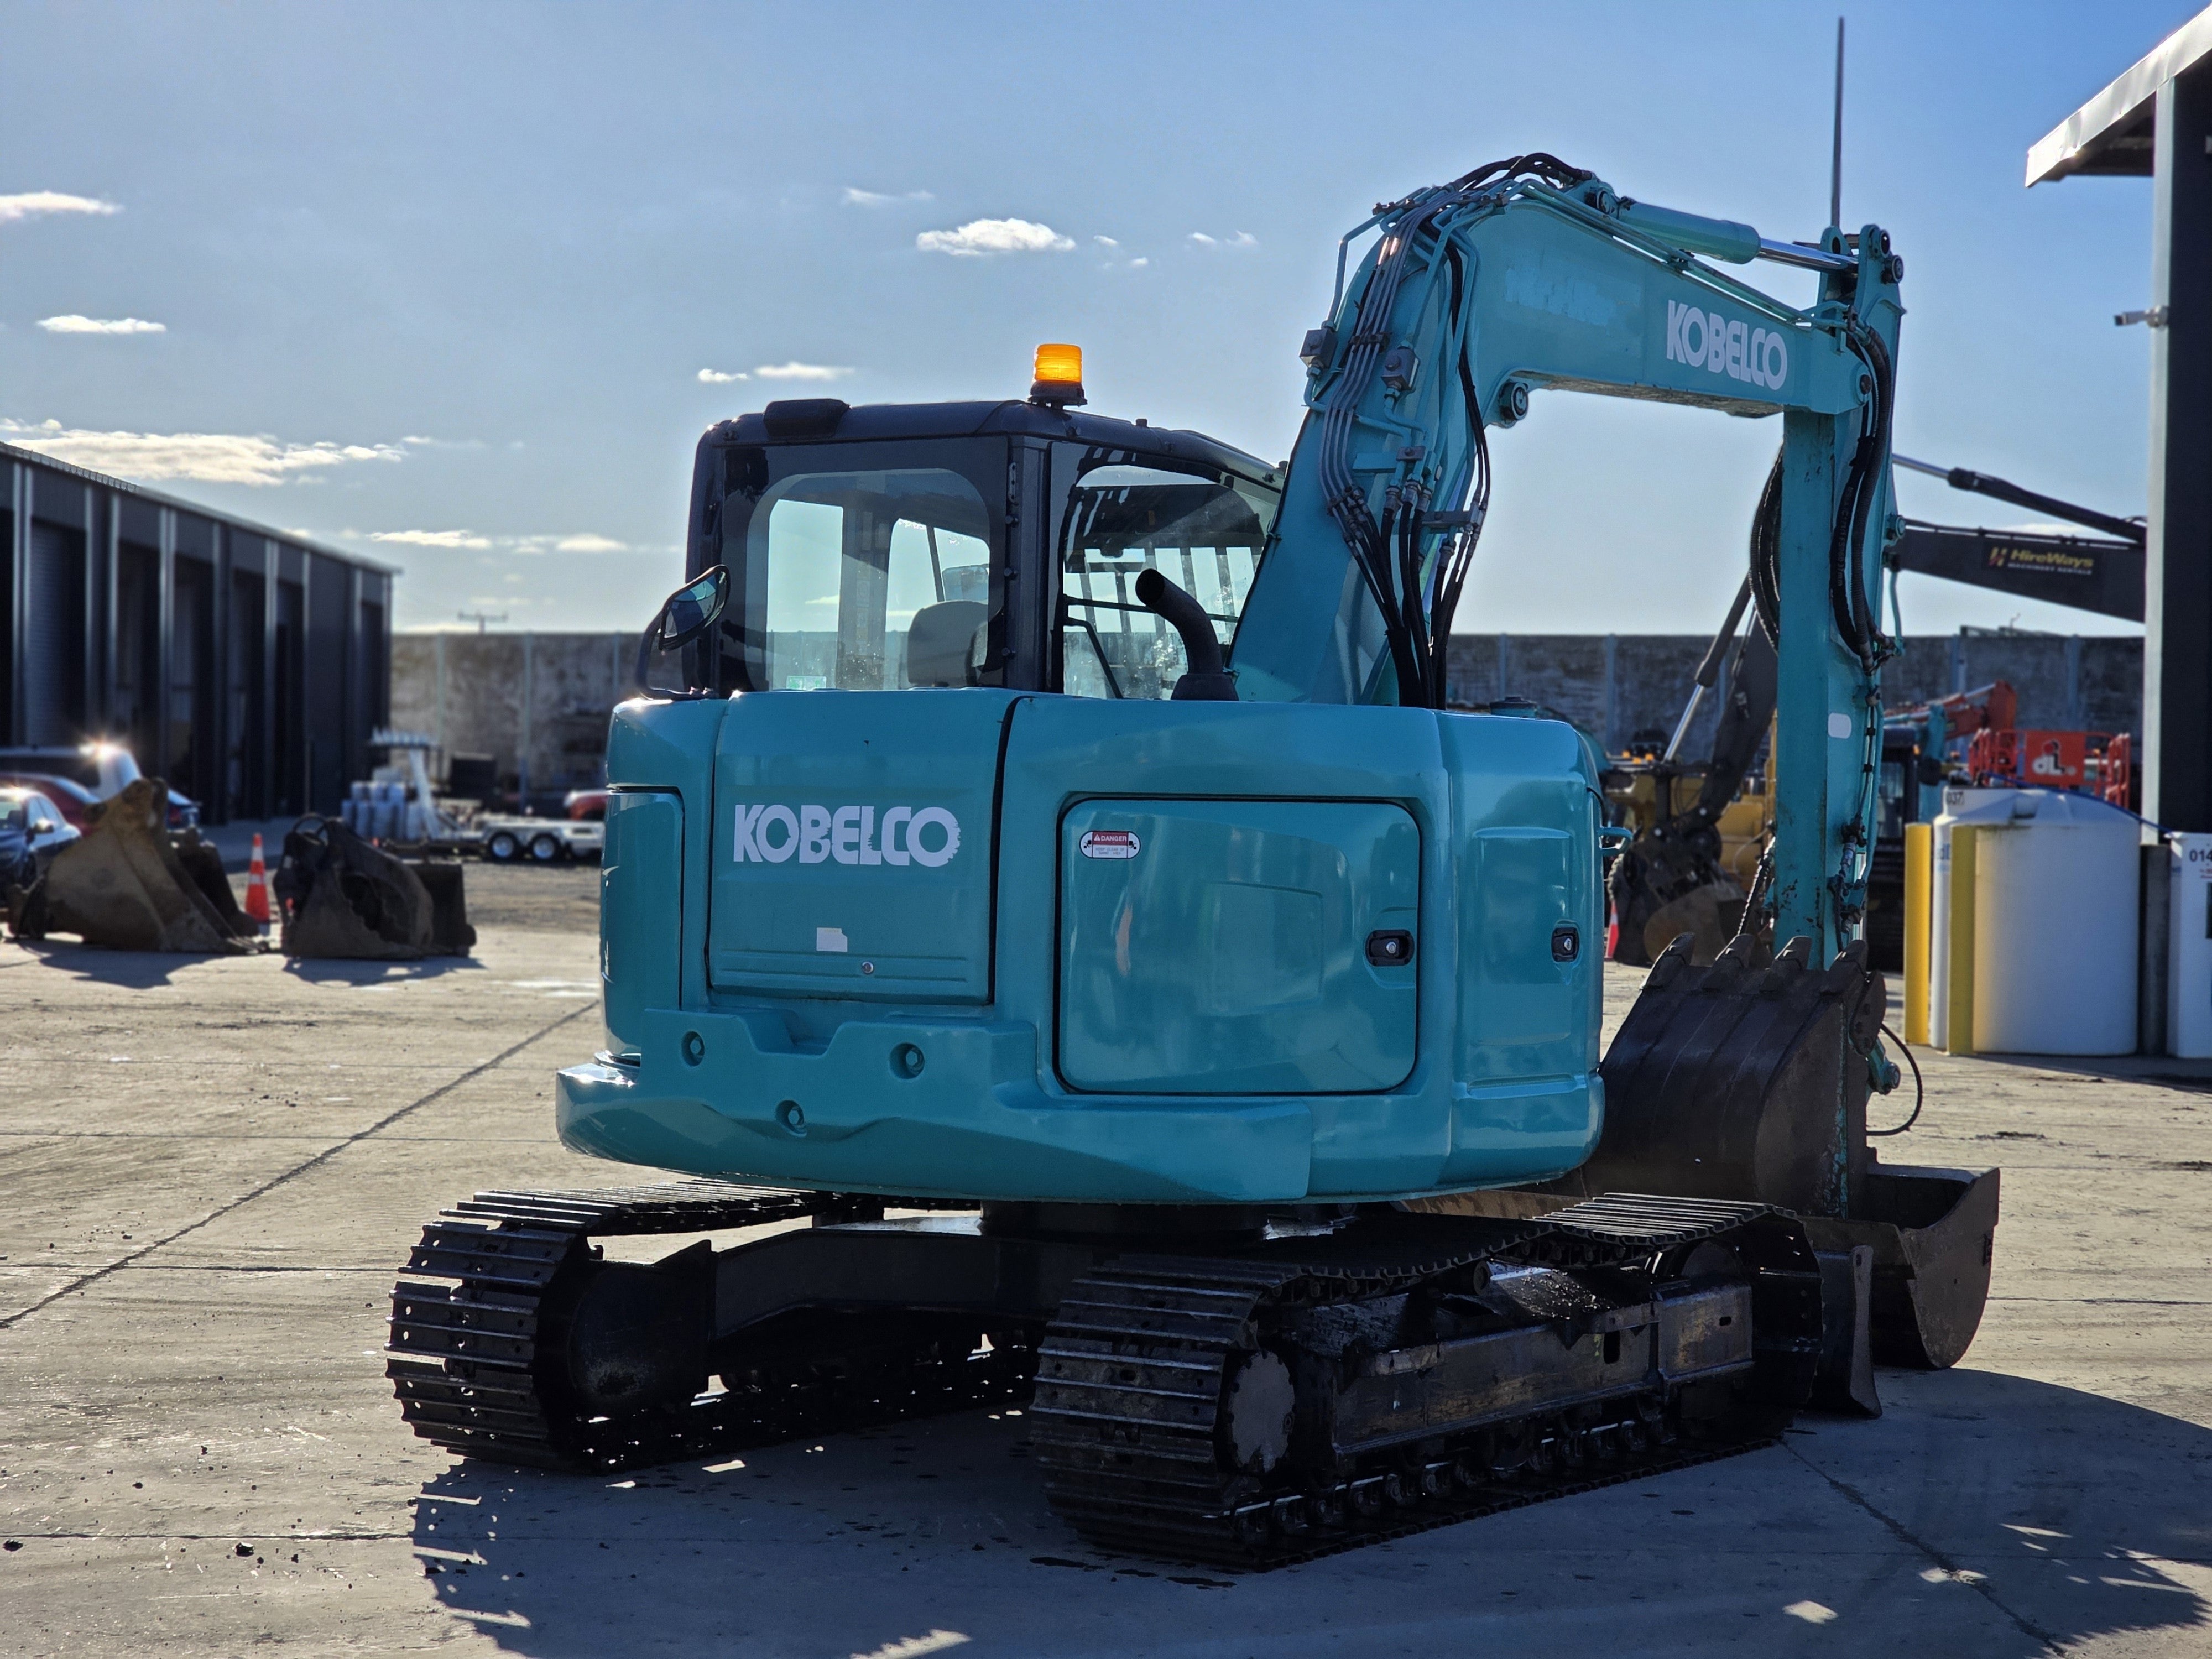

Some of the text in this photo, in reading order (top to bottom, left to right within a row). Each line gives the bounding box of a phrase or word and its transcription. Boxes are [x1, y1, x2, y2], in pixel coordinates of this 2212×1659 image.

[1667, 300, 1787, 390] KOBELCO
[2011, 549, 2094, 568] HireWays
[734, 804, 961, 867] KOBELCO
